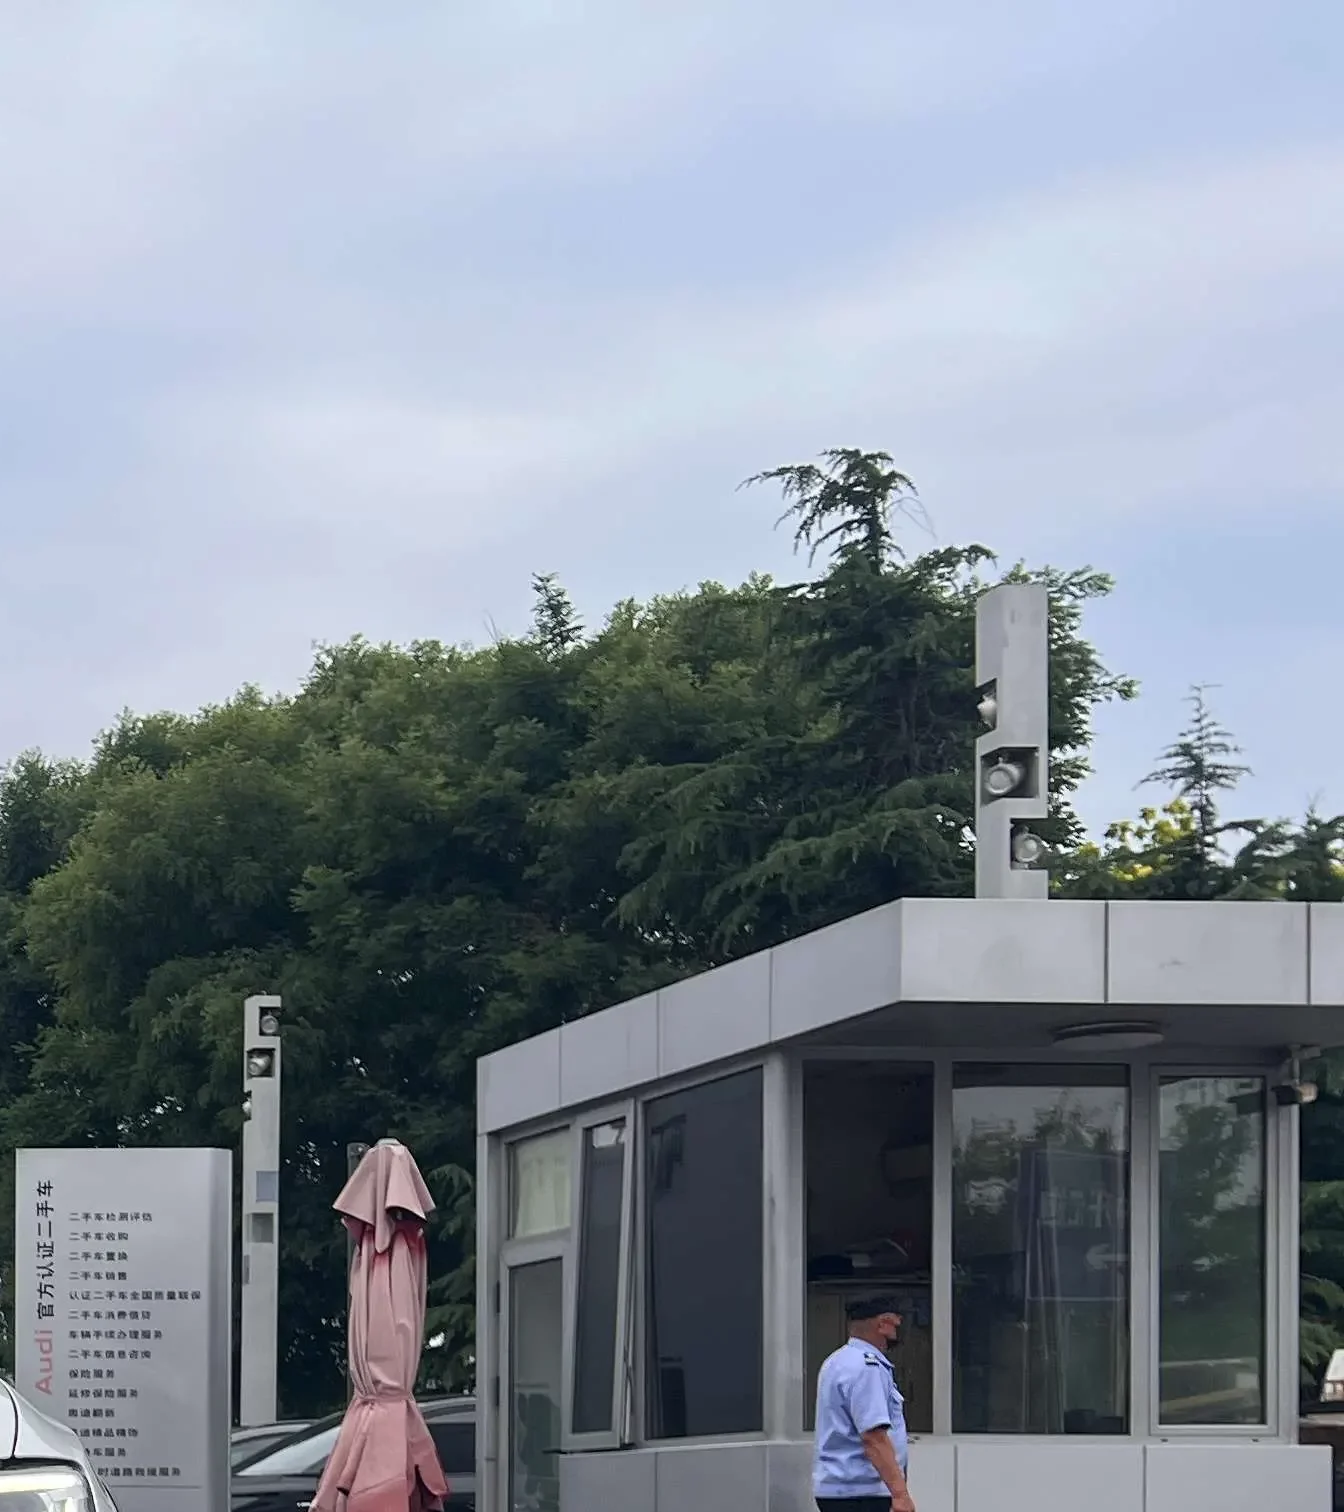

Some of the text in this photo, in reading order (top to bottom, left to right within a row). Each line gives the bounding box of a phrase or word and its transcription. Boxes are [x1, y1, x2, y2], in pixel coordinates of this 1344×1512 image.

[68, 1231, 129, 1242] 二手车收购
[68, 1251, 129, 1262] 二手车置换
[68, 1270, 128, 1281] 二手车销售
[34, 1179, 55, 1396] Audi 官方认证二手车
